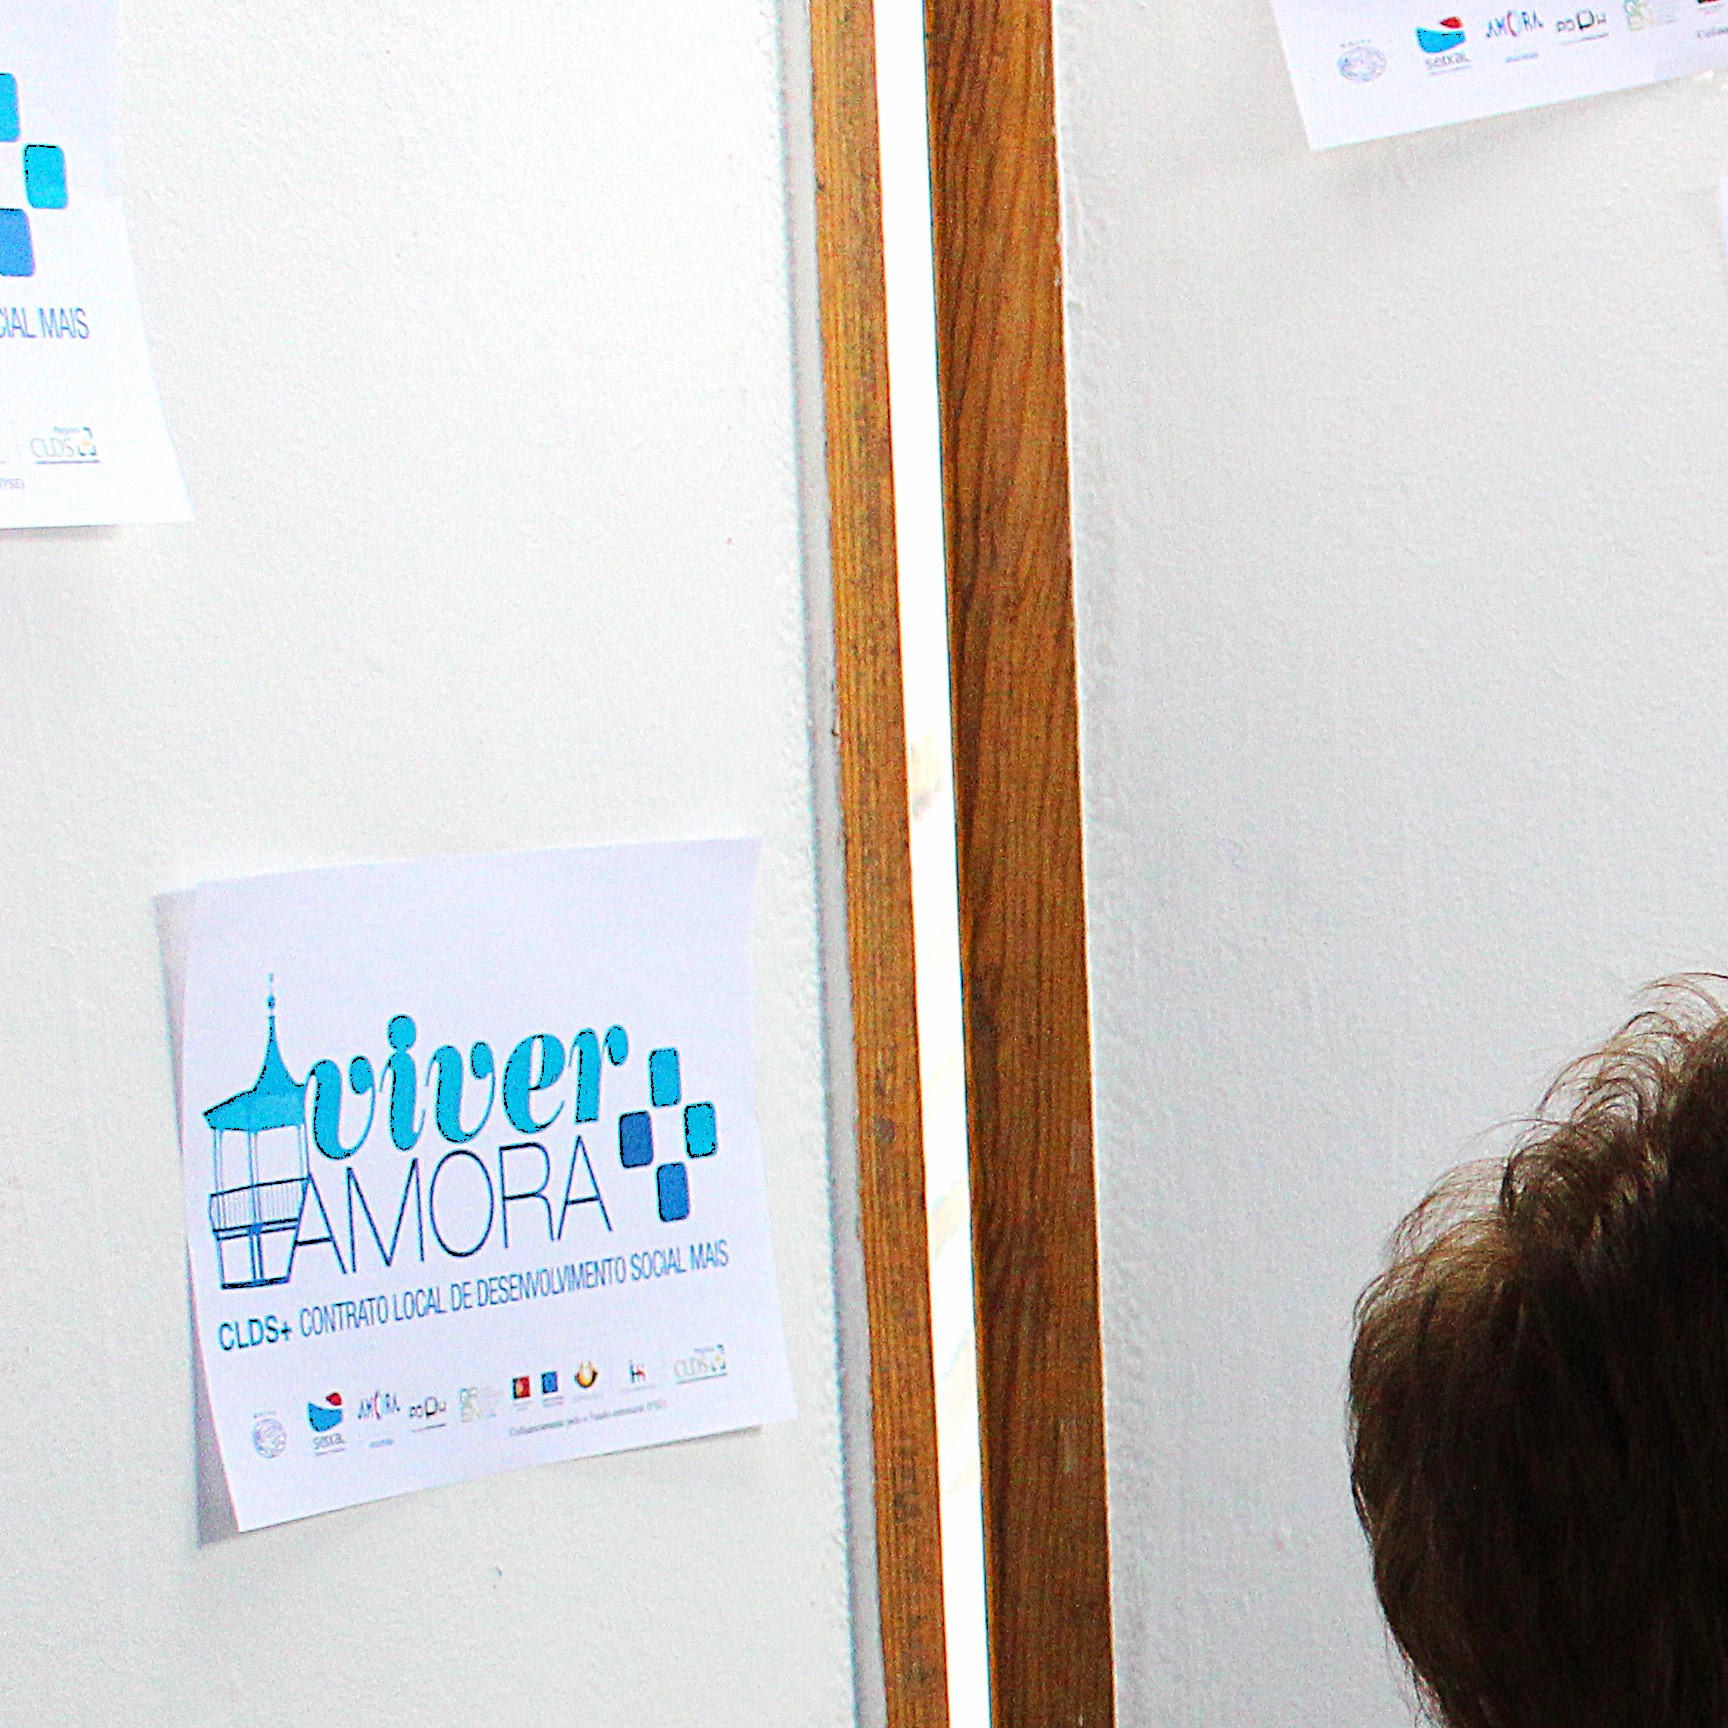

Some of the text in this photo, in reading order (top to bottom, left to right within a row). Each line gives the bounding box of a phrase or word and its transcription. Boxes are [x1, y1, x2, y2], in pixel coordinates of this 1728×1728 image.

[39, 307, 89, 339] MAIS
[303, 1014, 628, 1159] viver
[288, 1135, 612, 1277] AMORA
[218, 1238, 728, 1352] CLDS+ CONTRATO LOCAL DE DESENVOLVIMENTO SOCIAL MAIS
